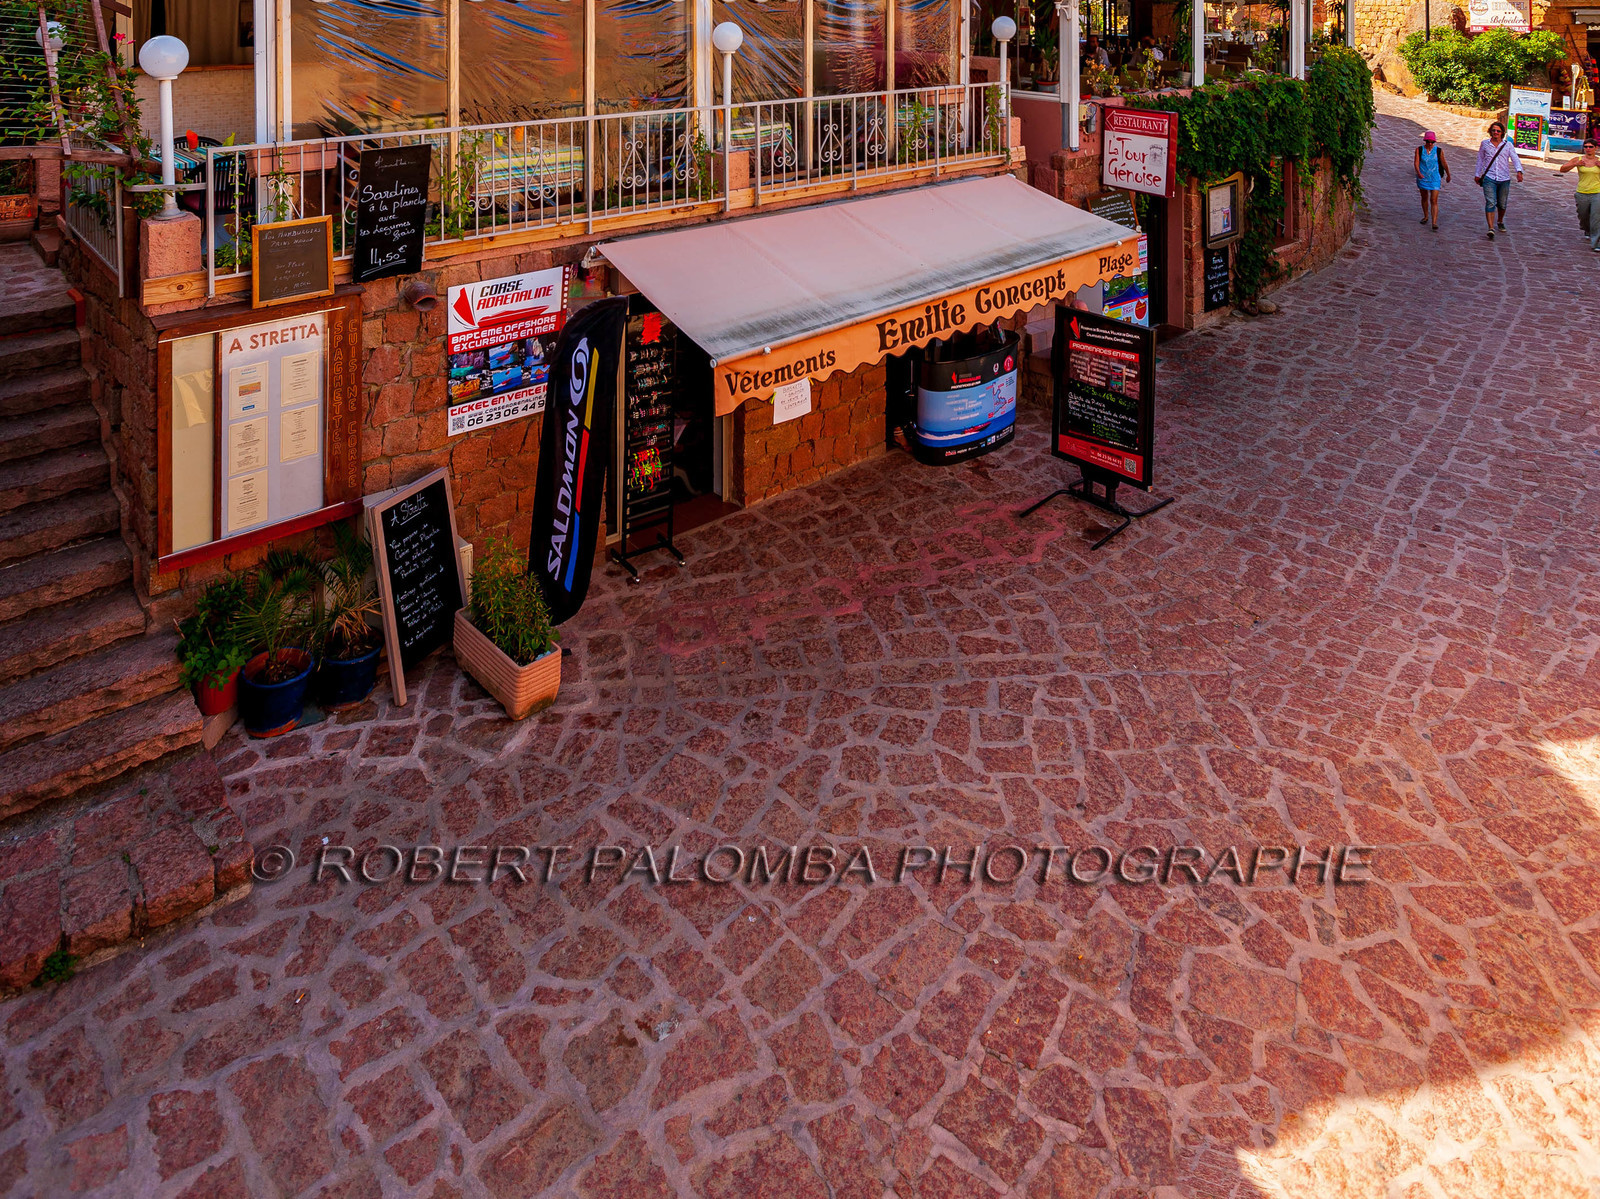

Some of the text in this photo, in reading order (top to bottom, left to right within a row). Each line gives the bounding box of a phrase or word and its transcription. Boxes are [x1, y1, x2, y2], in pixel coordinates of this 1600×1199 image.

[1113, 115, 1164, 131] RESTAURANT
[1108, 137, 1148, 164] La Tour
[1108, 158, 1162, 188] Génoise
[361, 180, 419, 203] Sardines
[380, 200, 388, 211] la
[378, 214, 399, 222] avec
[476, 285, 555, 311] ADRENALINE
[479, 279, 524, 298] CORSE
[451, 314, 557, 345] BAPTEME OFFSHORE
[453, 323, 556, 352] EXCURSIONS EN MER
[724, 348, 836, 396] Vêtements
[876, 299, 966, 353] Emilie
[974, 268, 1066, 315] Concept
[1098, 251, 1133, 275] Plage
[228, 322, 320, 355] A STRETTA
[1072, 342, 1112, 356] PROMENADES
[1121, 352, 1136, 360] MER
[347, 319, 358, 488] CUISINE CORSE
[450, 401, 490, 417] TICKET
[491, 396, 506, 407] EN
[506, 387, 542, 402] VENTE
[467, 415, 484, 428] 06
[485, 411, 502, 423] 23
[503, 407, 519, 418] 06
[521, 403, 537, 415] 44
[547, 408, 580, 581] SALOMON
[391, 493, 428, 527] A Stretta
